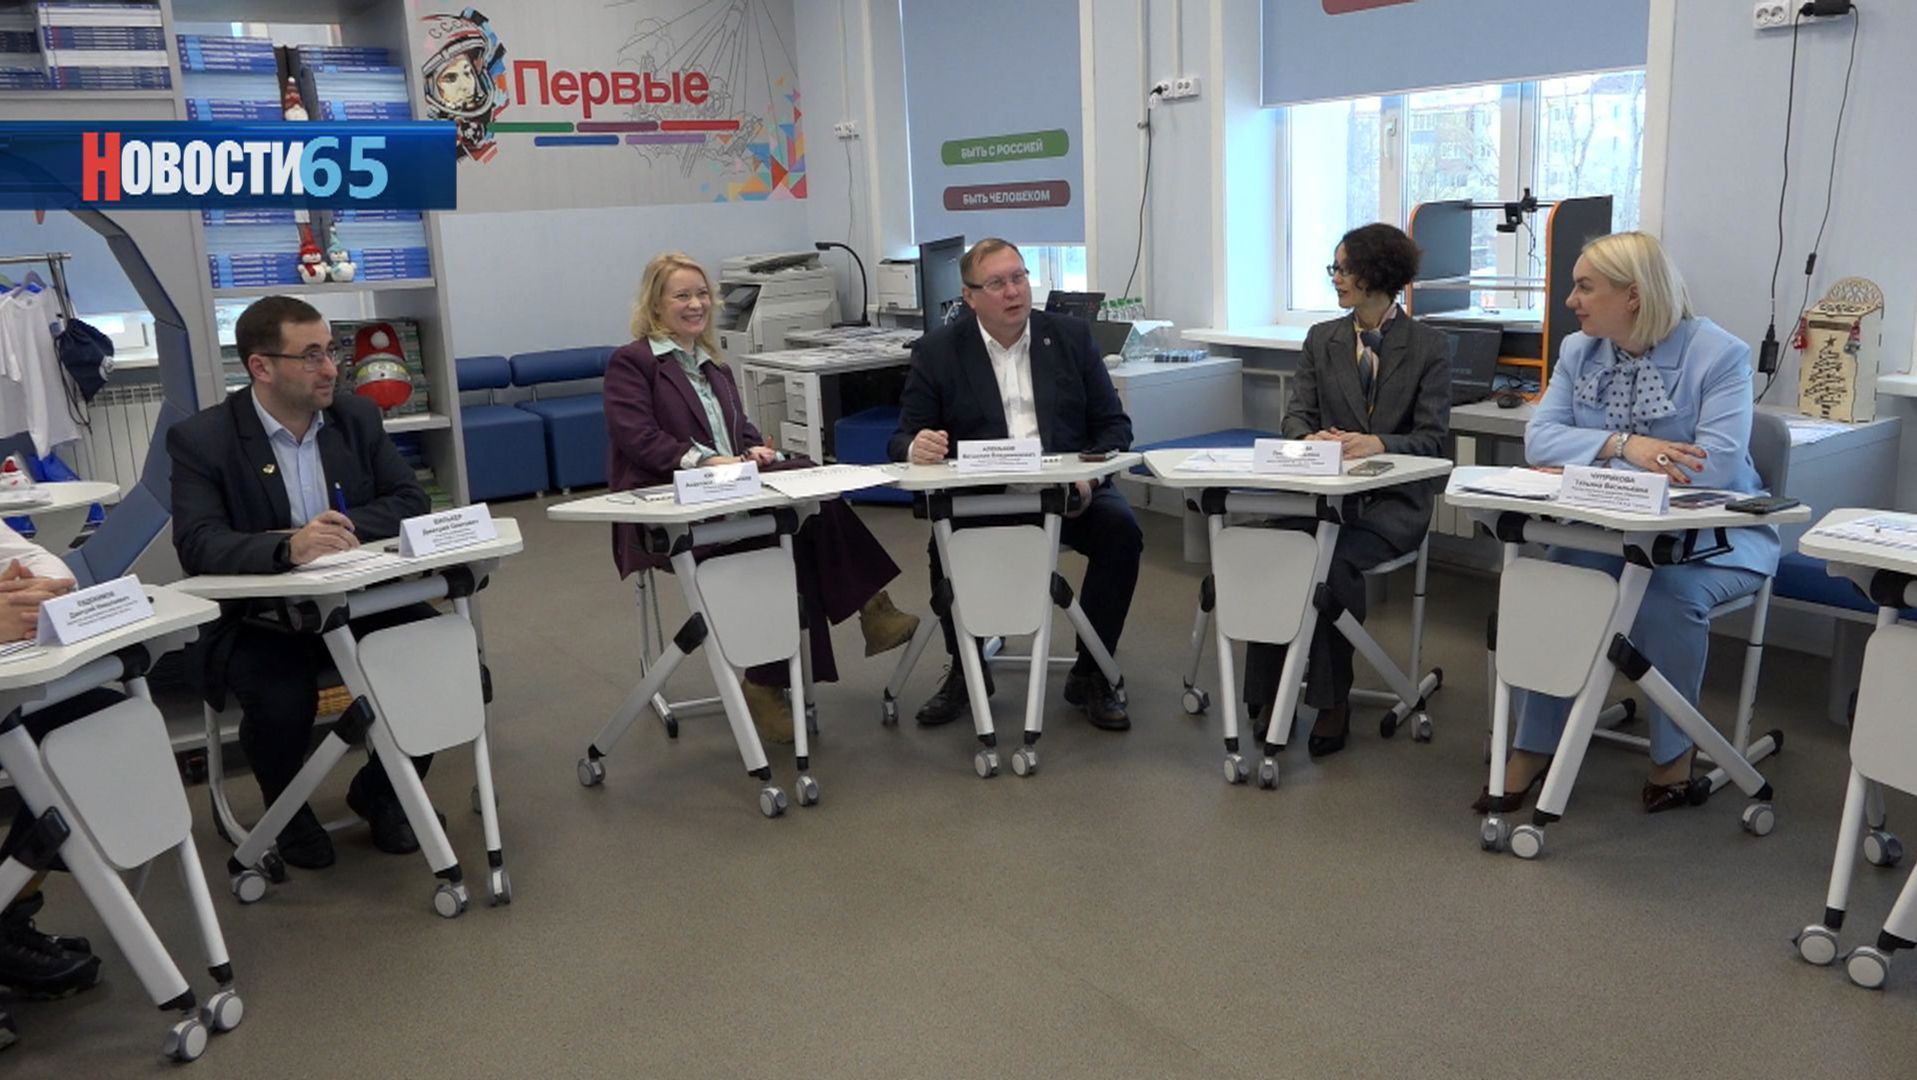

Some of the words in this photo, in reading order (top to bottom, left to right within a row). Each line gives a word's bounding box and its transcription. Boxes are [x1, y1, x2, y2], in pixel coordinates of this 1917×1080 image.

[513, 60, 709, 119] Первые
[961, 147, 987, 159] БЫТЬ
[988, 145, 996, 156] С
[997, 138, 1044, 155] РОССИЕЙ
[963, 193, 988, 205] БЫТЬ
[989, 190, 1050, 203] ЧЕЛОВЕКОМ
